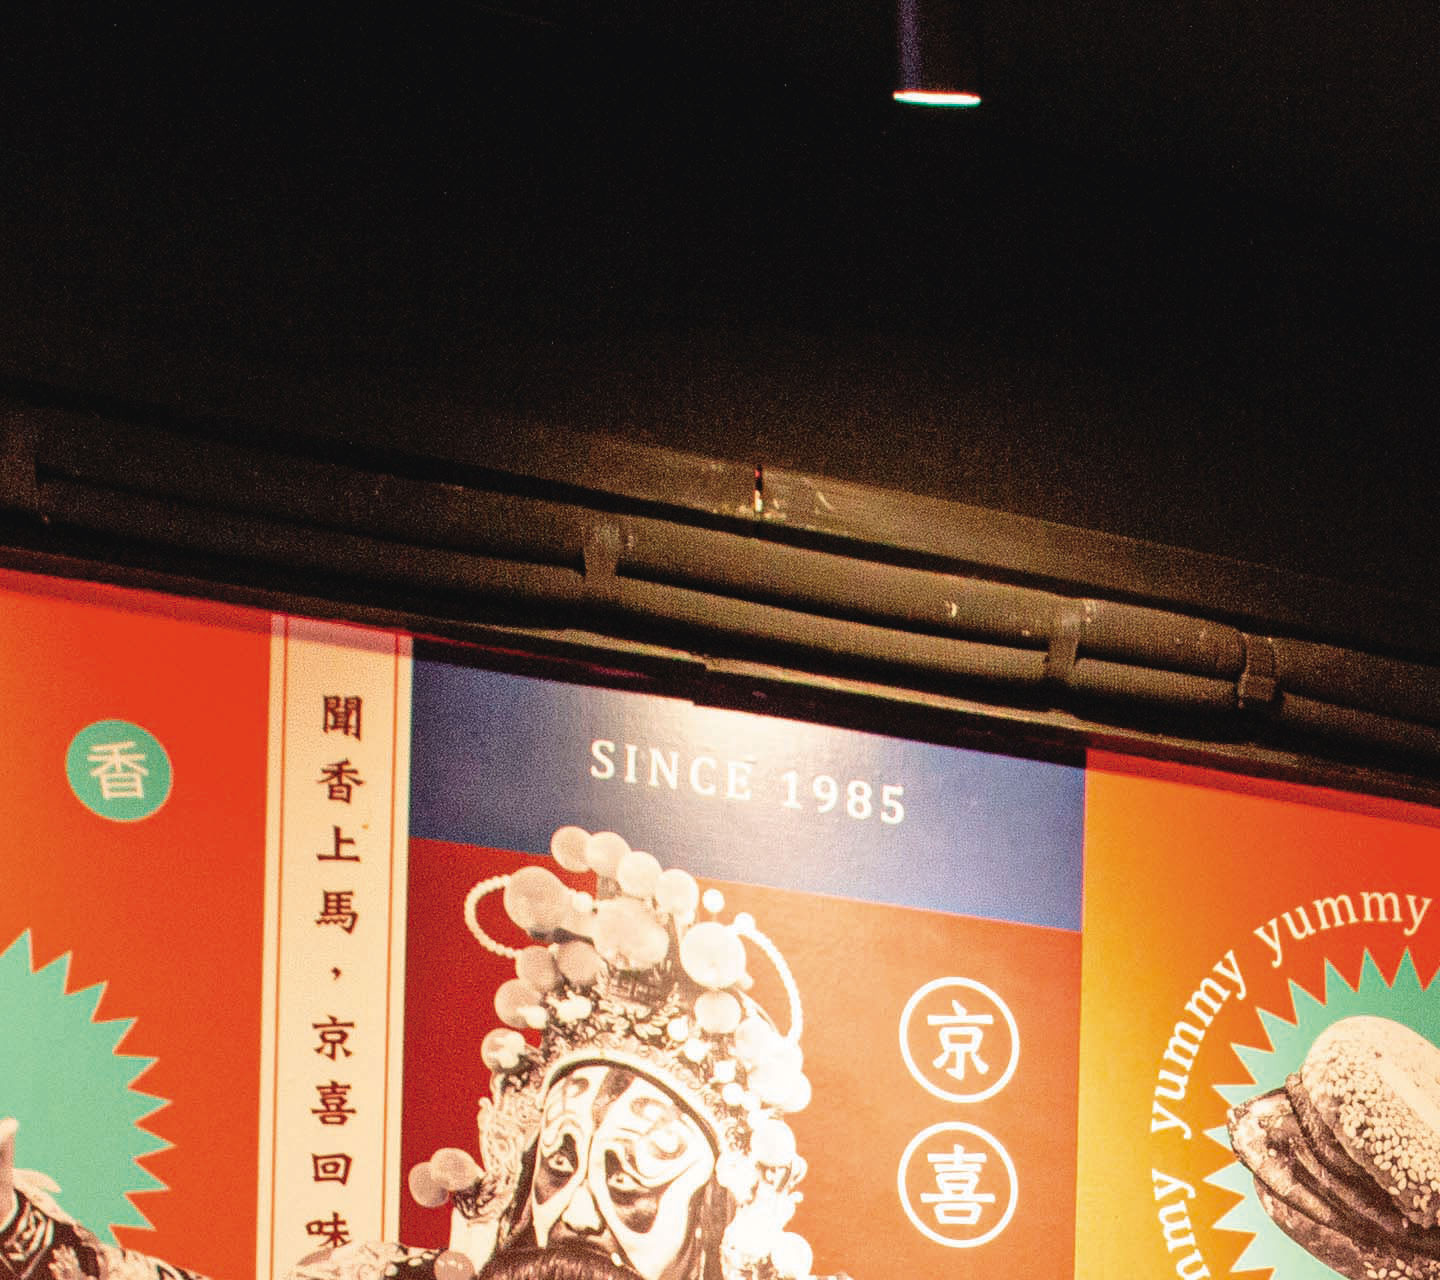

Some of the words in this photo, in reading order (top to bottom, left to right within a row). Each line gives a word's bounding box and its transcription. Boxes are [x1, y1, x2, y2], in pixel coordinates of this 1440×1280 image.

[89, 740, 149, 801] 香
[591, 738, 753, 801] SINCE
[778, 770, 907, 825] 1985
[1253, 890, 1432, 967] yummy
[927, 1000, 994, 1080] 京
[1150, 949, 1249, 1139] yummy
[920, 1144, 996, 1226] 喜
